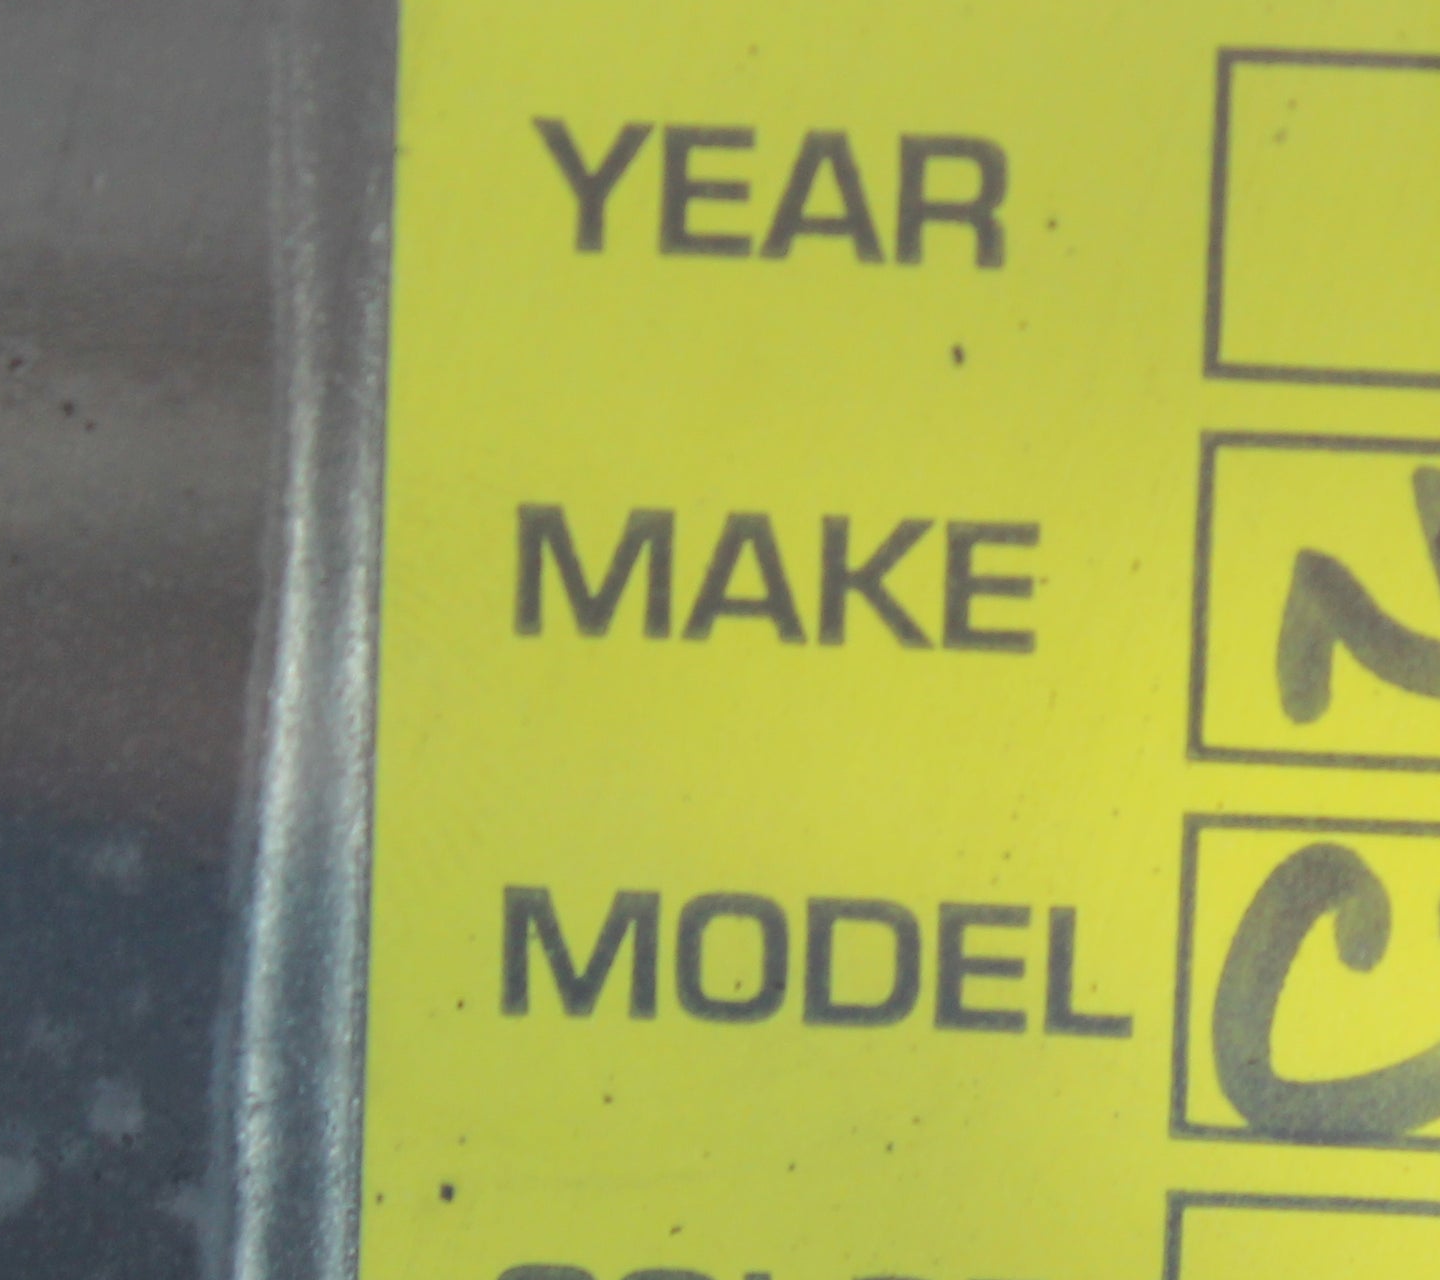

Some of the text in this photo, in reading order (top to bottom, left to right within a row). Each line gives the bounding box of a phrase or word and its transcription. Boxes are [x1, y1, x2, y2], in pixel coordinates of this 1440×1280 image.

[534, 120, 1007, 268] YEAR
[515, 505, 1040, 654] MAKE
[501, 886, 1132, 1038] MODEL
